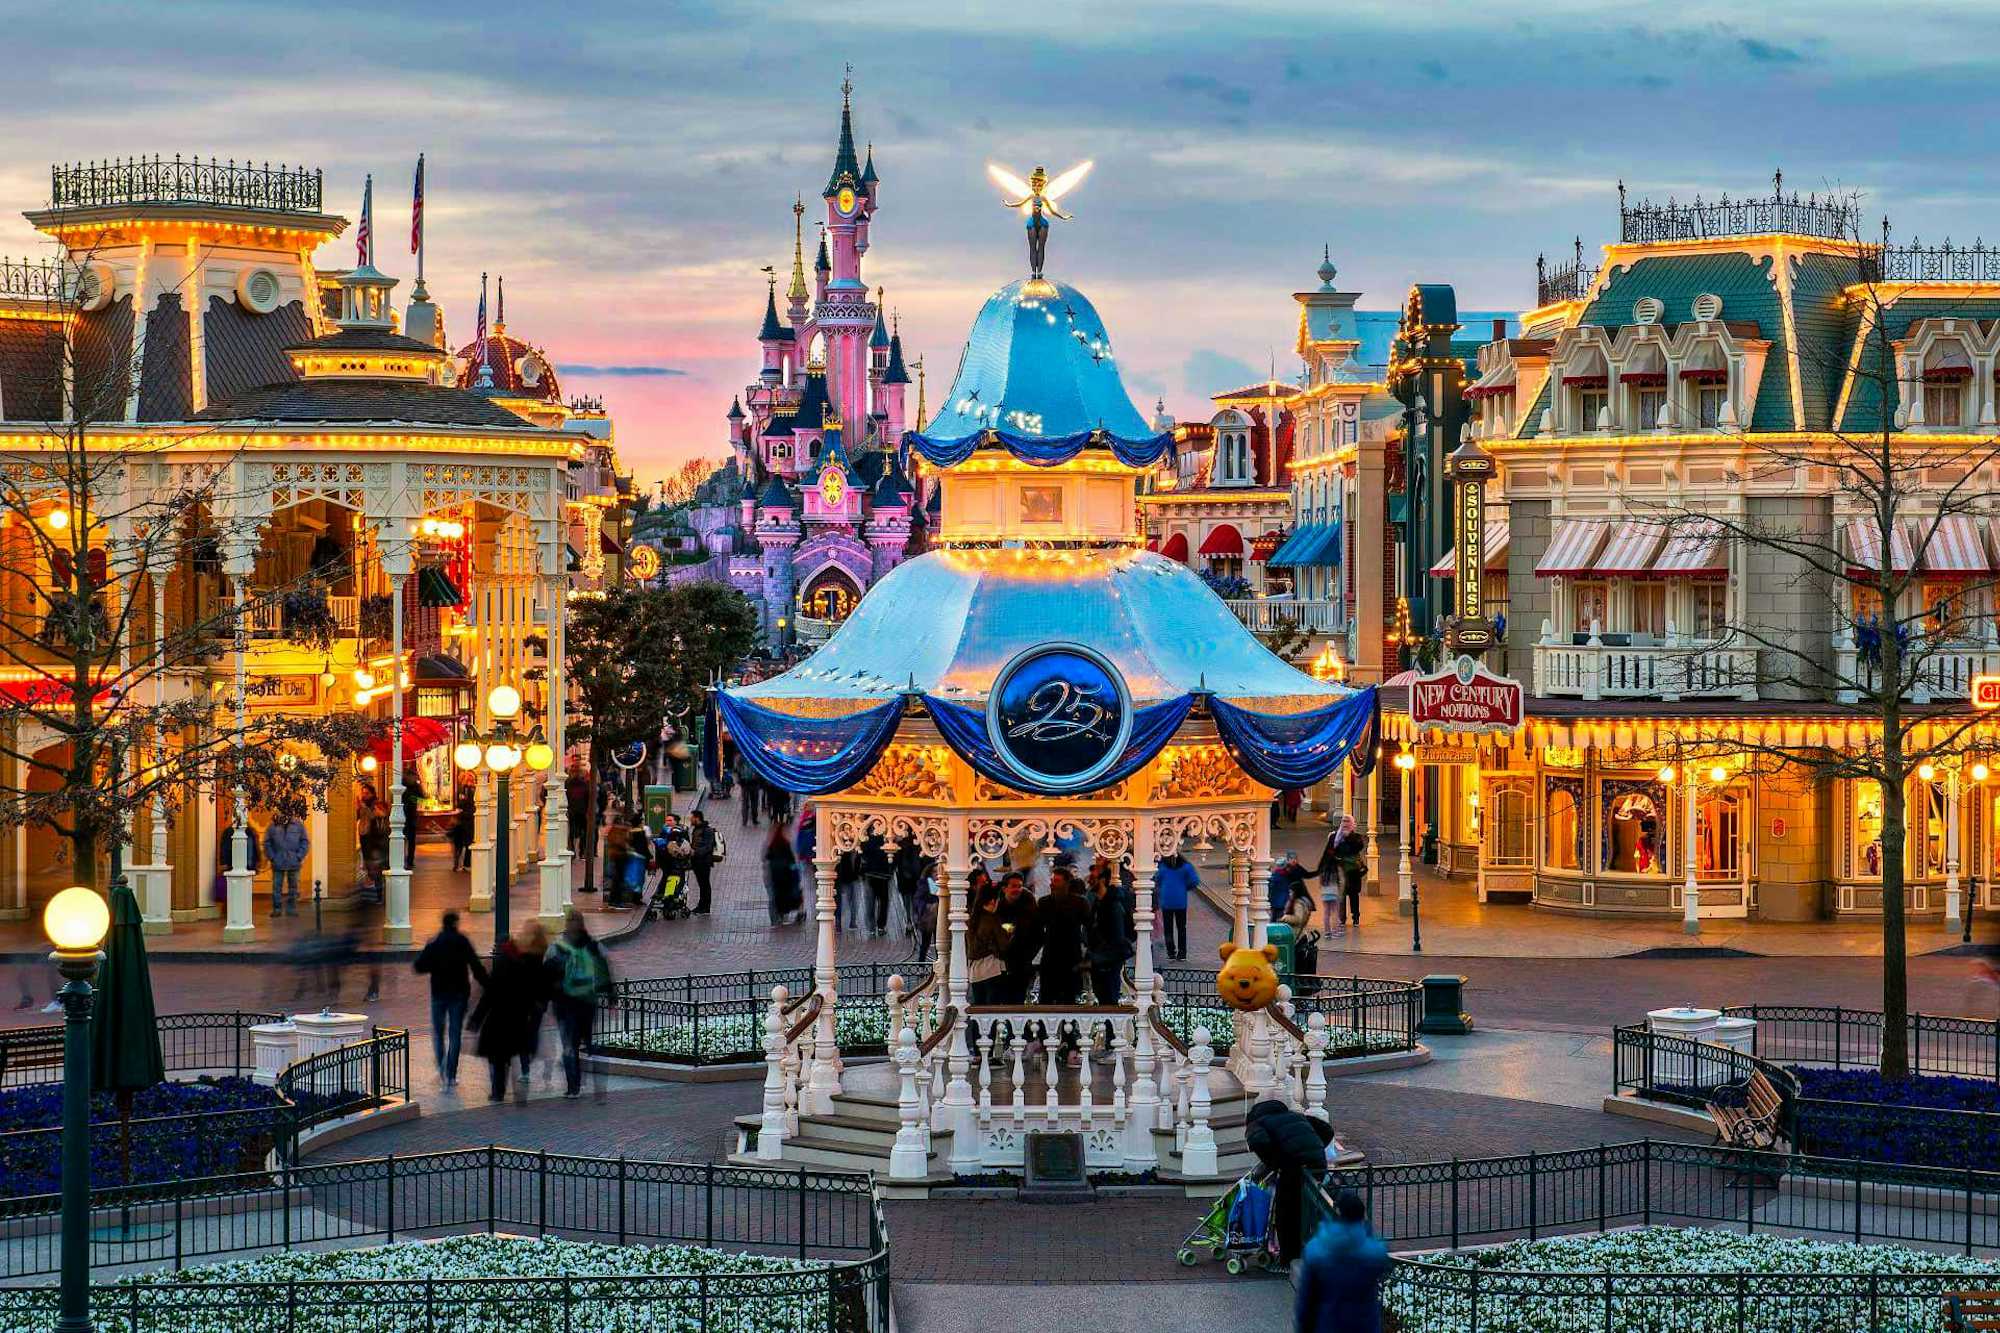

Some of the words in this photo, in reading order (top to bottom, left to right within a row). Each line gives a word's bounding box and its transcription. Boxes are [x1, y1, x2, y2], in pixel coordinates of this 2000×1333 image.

[1466, 496, 1478, 605] SOUVENIRS
[1008, 679, 1111, 742] 25
[1416, 684, 1449, 717] NEW
[1450, 684, 1515, 720] CENTURY
[1440, 703, 1490, 719] NOTIONS
